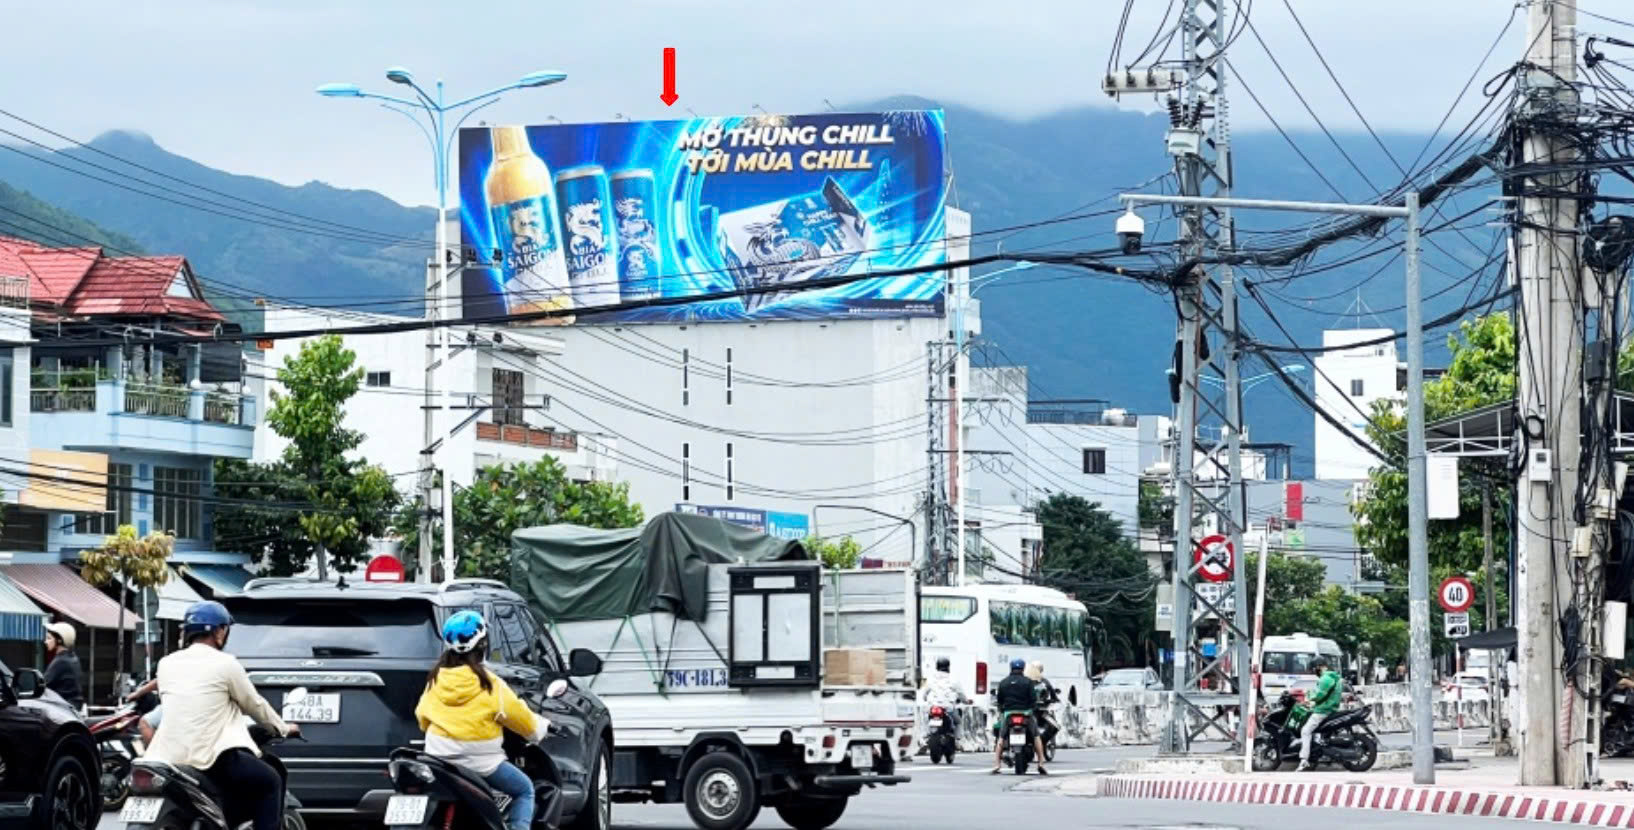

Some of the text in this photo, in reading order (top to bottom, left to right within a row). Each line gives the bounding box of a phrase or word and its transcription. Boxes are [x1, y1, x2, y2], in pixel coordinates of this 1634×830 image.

[822, 124, 894, 145] CHILL
[734, 146, 792, 171] MÙA
[800, 150, 872, 170] CHILL
[578, 245, 597, 255] BIA
[1449, 586, 1463, 602] 40
